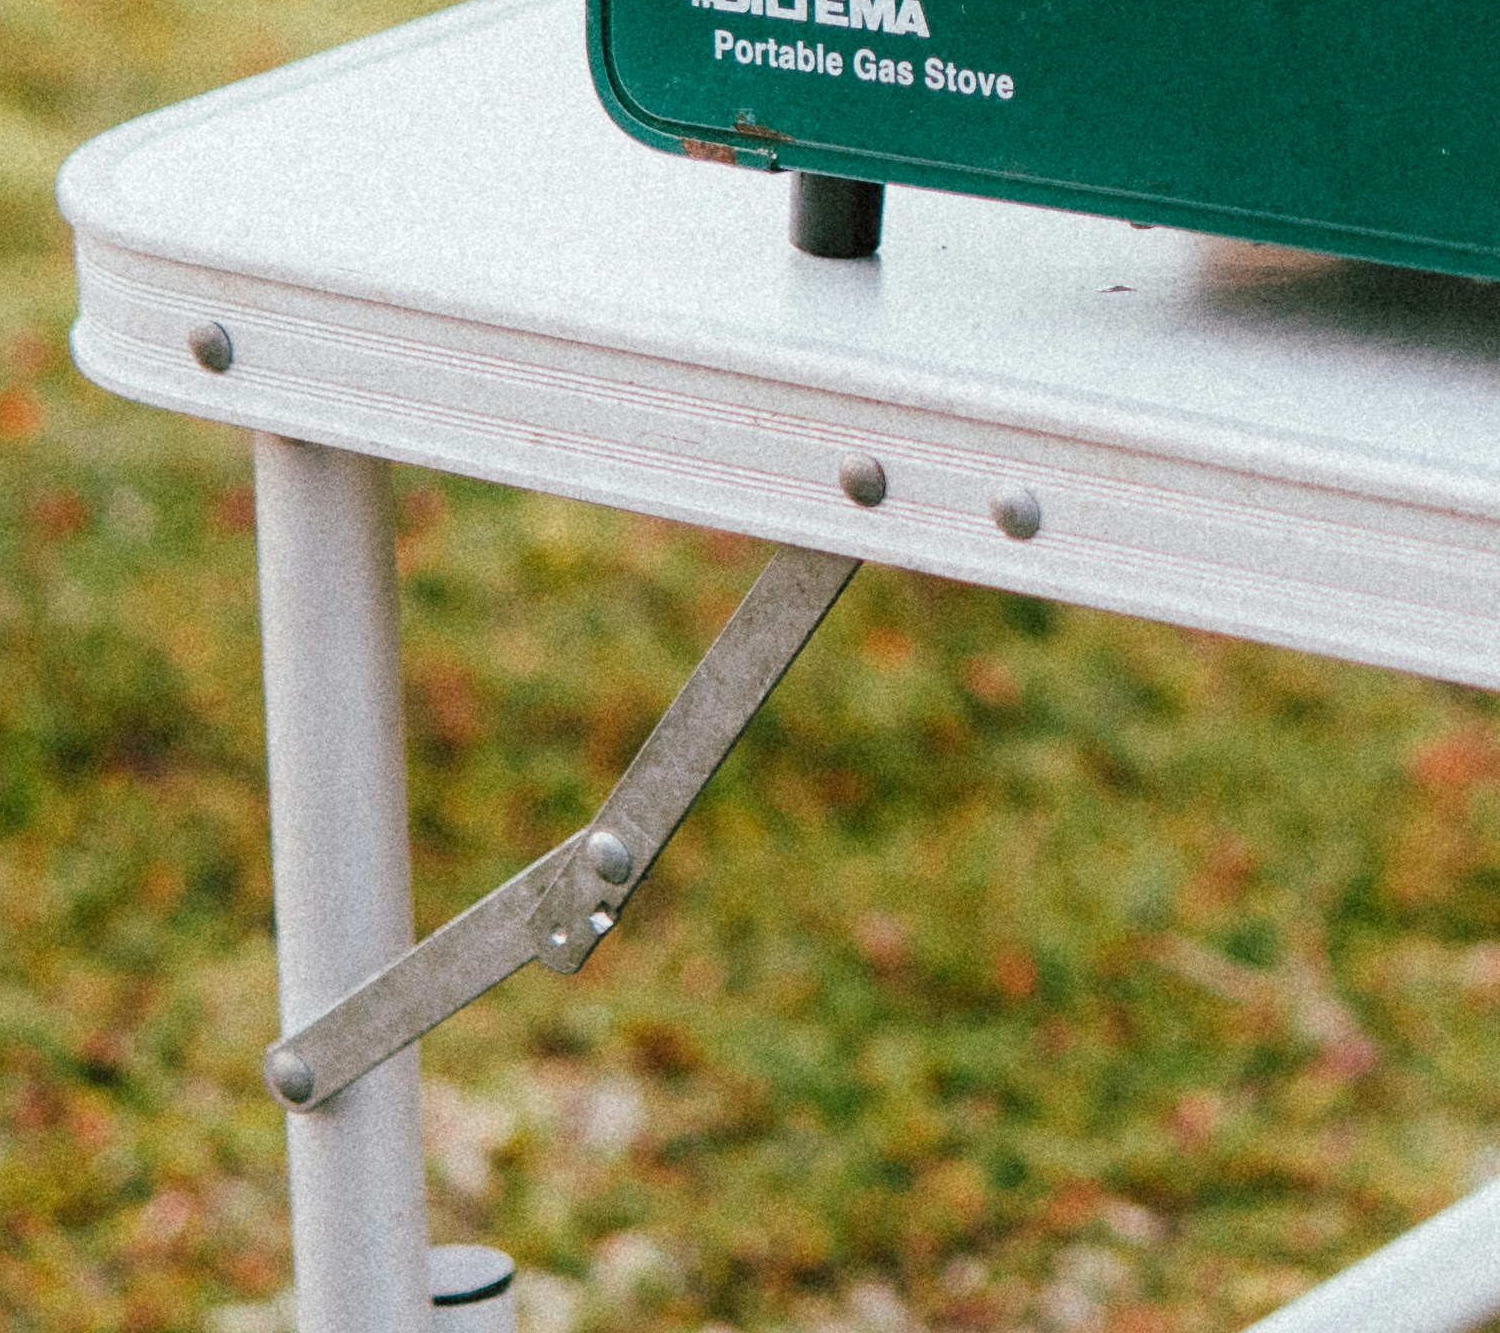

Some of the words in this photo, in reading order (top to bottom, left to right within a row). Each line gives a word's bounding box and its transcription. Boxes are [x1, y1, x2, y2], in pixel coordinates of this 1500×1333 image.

[713, 29, 844, 77] Portable
[853, 48, 914, 86] Gas
[924, 57, 1015, 100] Stove
